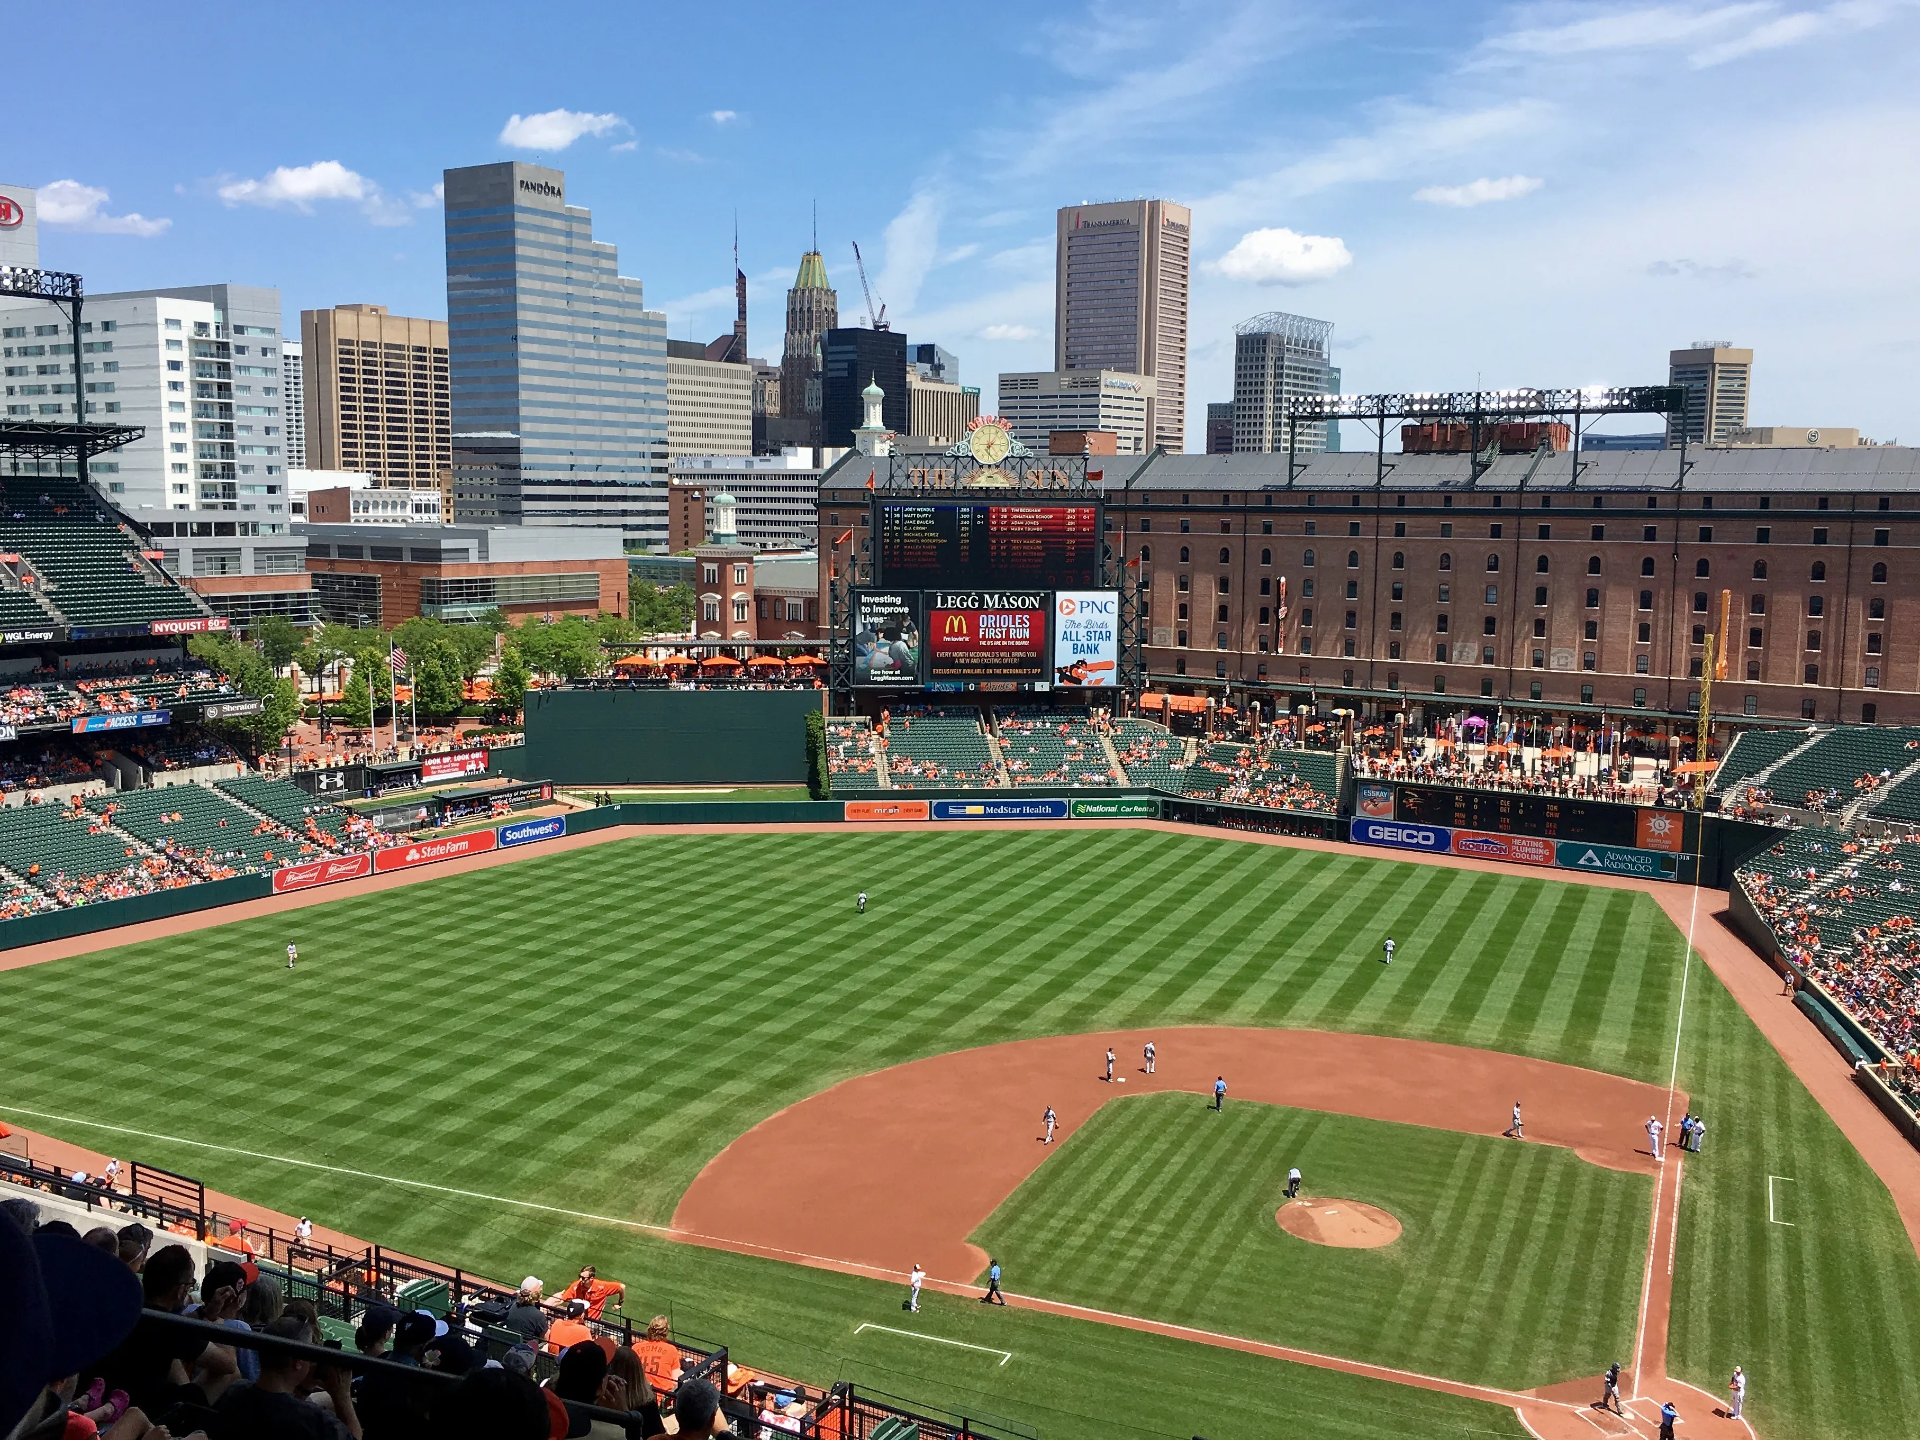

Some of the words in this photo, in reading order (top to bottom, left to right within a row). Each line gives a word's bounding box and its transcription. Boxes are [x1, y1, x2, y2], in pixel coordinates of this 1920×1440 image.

[520, 180, 562, 198] PANDORA
[909, 468, 955, 488] THE
[1025, 470, 1069, 488] SUN
[861, 595, 901, 604] Investing
[936, 593, 979, 608] LEGG
[983, 594, 1040, 609] MASON
[873, 605, 909, 614] Improve
[1079, 601, 1115, 614] PNC
[979, 615, 1030, 628] ORIOLES
[1065, 619, 1082, 629] The
[1083, 619, 1109, 629] Birds
[155, 622, 202, 633] NYQUIST
[4, 632, 24, 640] WGL
[25, 631, 53, 640] Energy
[979, 628, 1007, 639] FIRST
[1010, 628, 1030, 638] RUN
[1062, 631, 1111, 641] ALL-STAR
[1073, 644, 1100, 654] BANK
[222, 703, 257, 712] Sheraton
[110, 715, 137, 728] ACCESS
[506, 823, 552, 841] Southwest
[1368, 826, 1435, 845] GEICO
[1460, 842, 1508, 855] HORIZON
[1512, 839, 1543, 848] HEATING
[1512, 846, 1549, 856] PLUMBING
[1512, 852, 1543, 861] COOLING
[1606, 851, 1652, 863] ADVANCED
[328, 863, 359, 874] Budweiser
[1604, 860, 1654, 872] RADIOLOGY
[286, 871, 317, 882] Budweiser
[638, 1346, 667, 1354] TRUMBO
